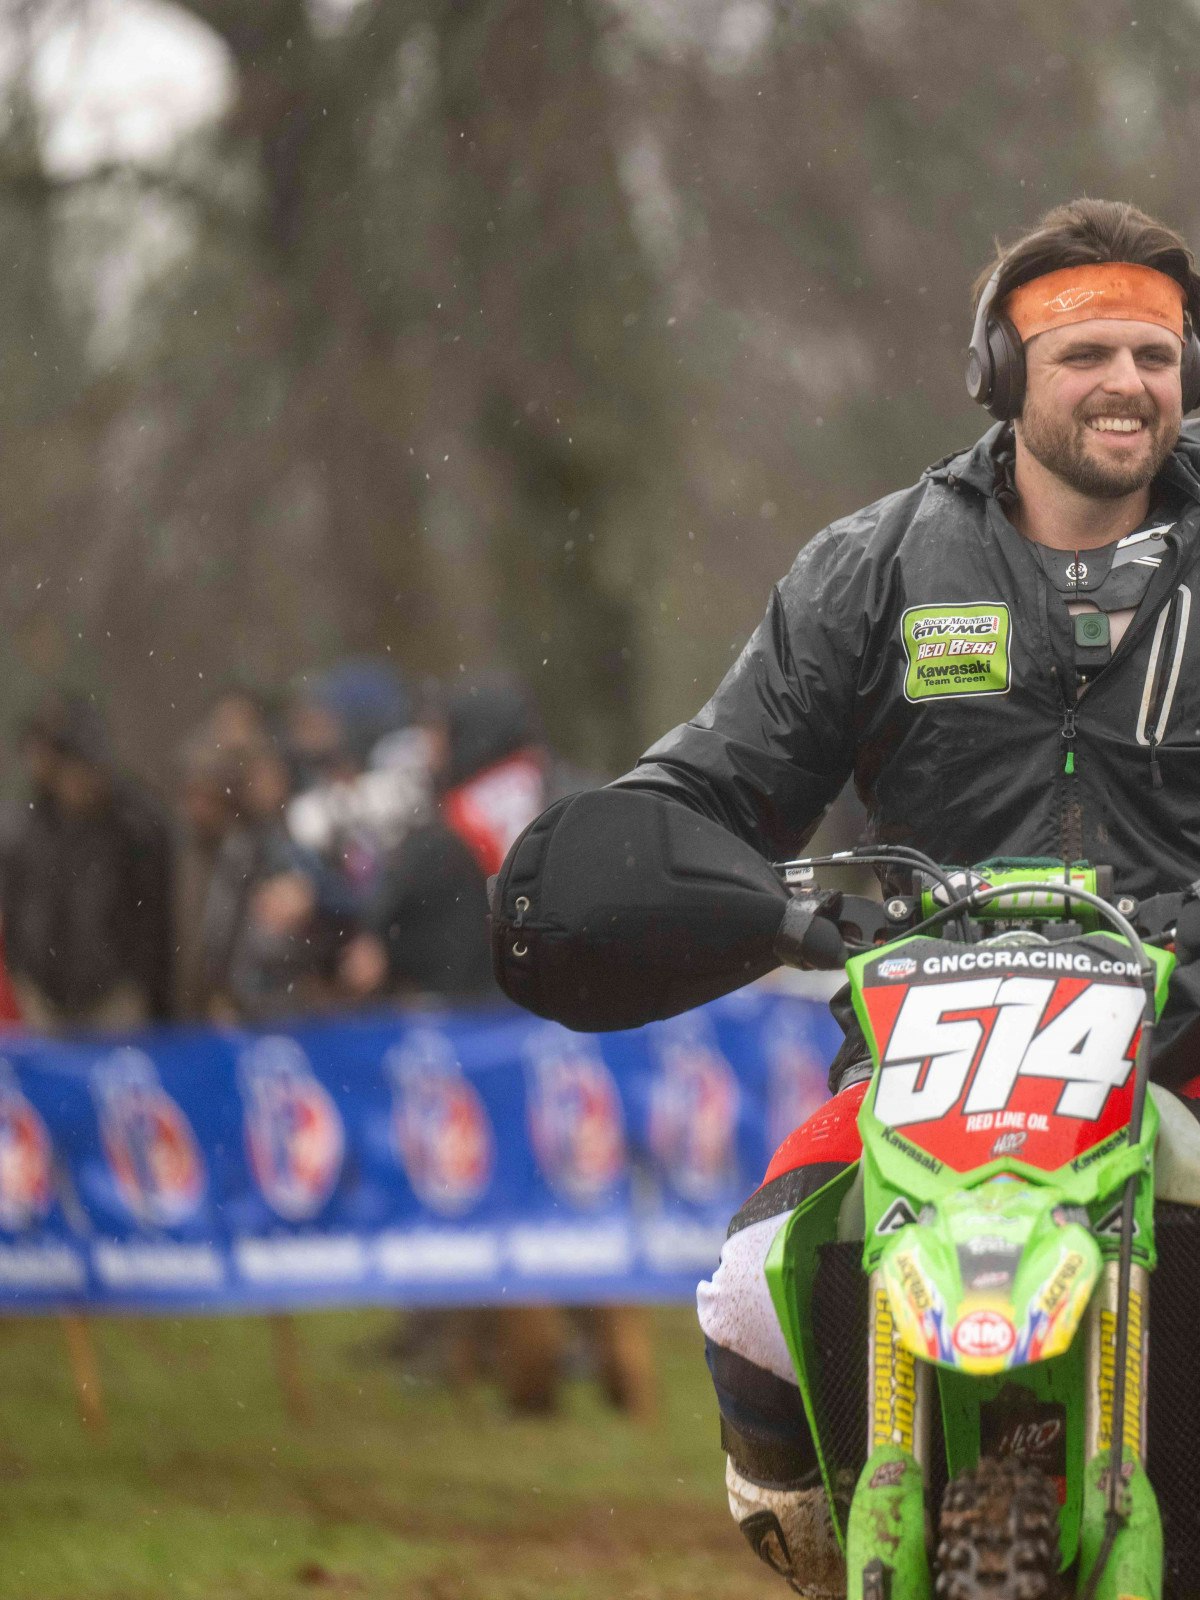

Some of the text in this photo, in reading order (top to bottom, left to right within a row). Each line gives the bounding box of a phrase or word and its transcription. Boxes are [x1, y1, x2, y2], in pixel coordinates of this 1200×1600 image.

[923, 618, 949, 626] ROCKY
[950, 616, 993, 626] MOUNTAIN
[915, 642, 947, 662] RED
[917, 660, 991, 679] Kawasaki
[924, 675, 986, 686] Team Green
[873, 976, 1147, 1127] 514
[966, 1111, 1050, 1133] RED LINE OIL
[881, 1126, 943, 1176] Kawasaki
[1071, 1128, 1129, 1173] Kawasak
